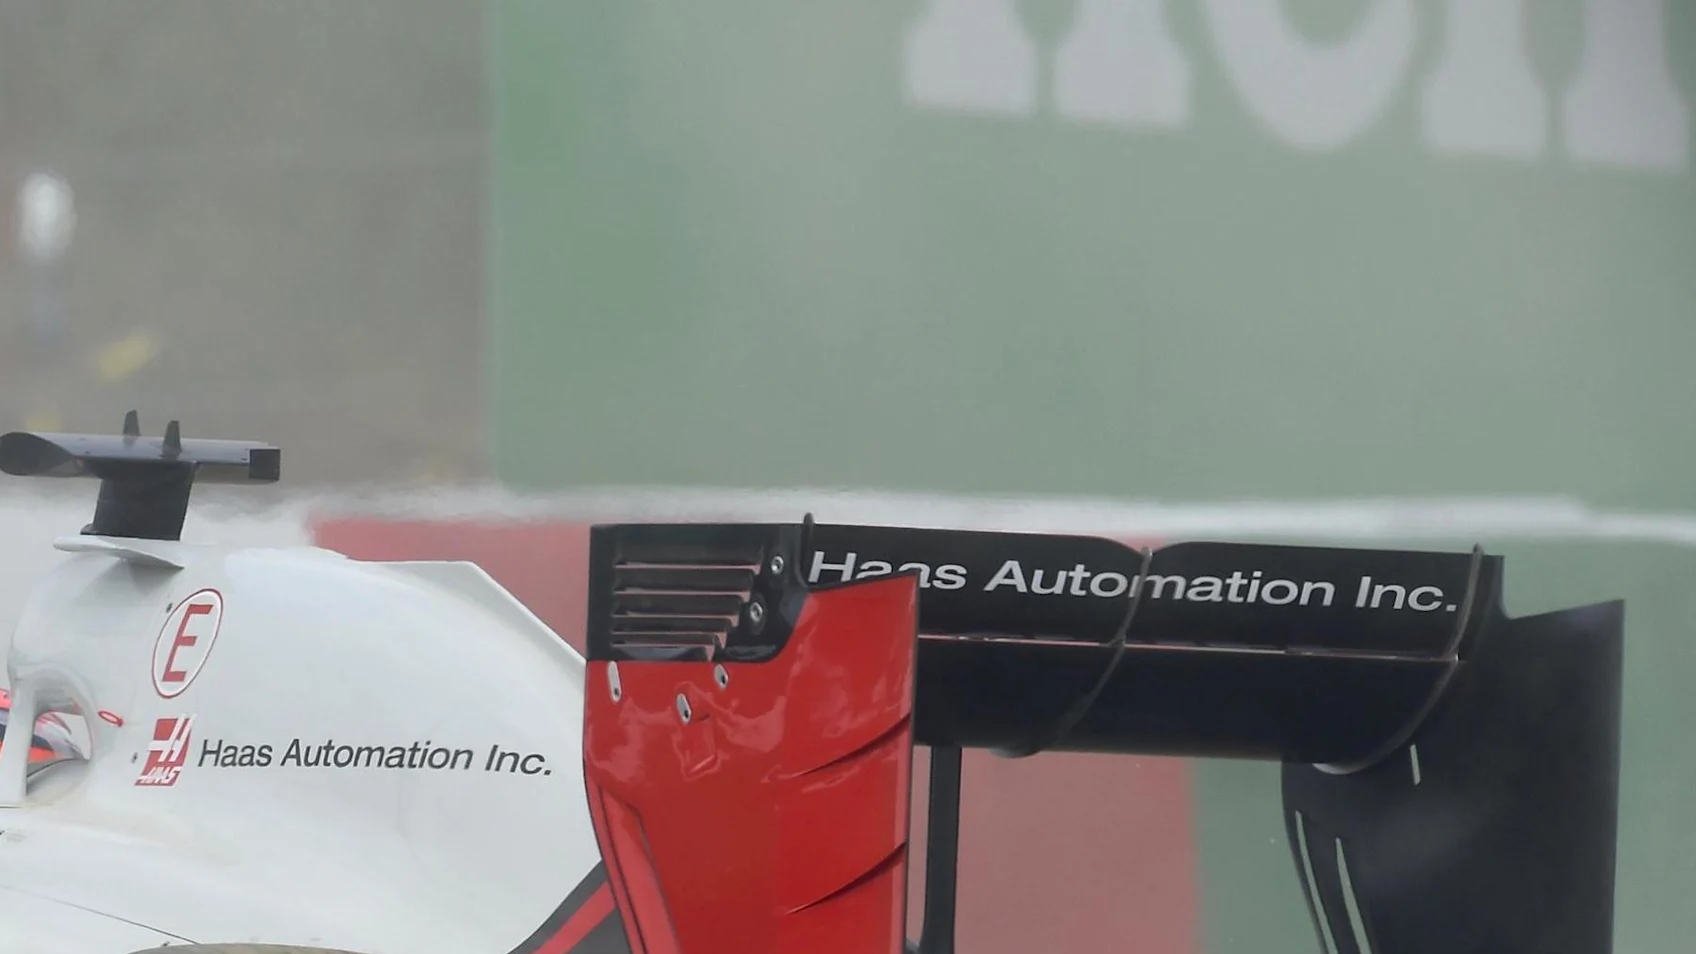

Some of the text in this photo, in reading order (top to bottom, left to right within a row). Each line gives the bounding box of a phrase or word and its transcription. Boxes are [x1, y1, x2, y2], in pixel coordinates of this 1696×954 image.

[983, 560, 1335, 606] Automation
[1355, 576, 1457, 612] Inc.
[161, 603, 214, 683] E
[197, 738, 552, 776] Haas Automation Inc.
